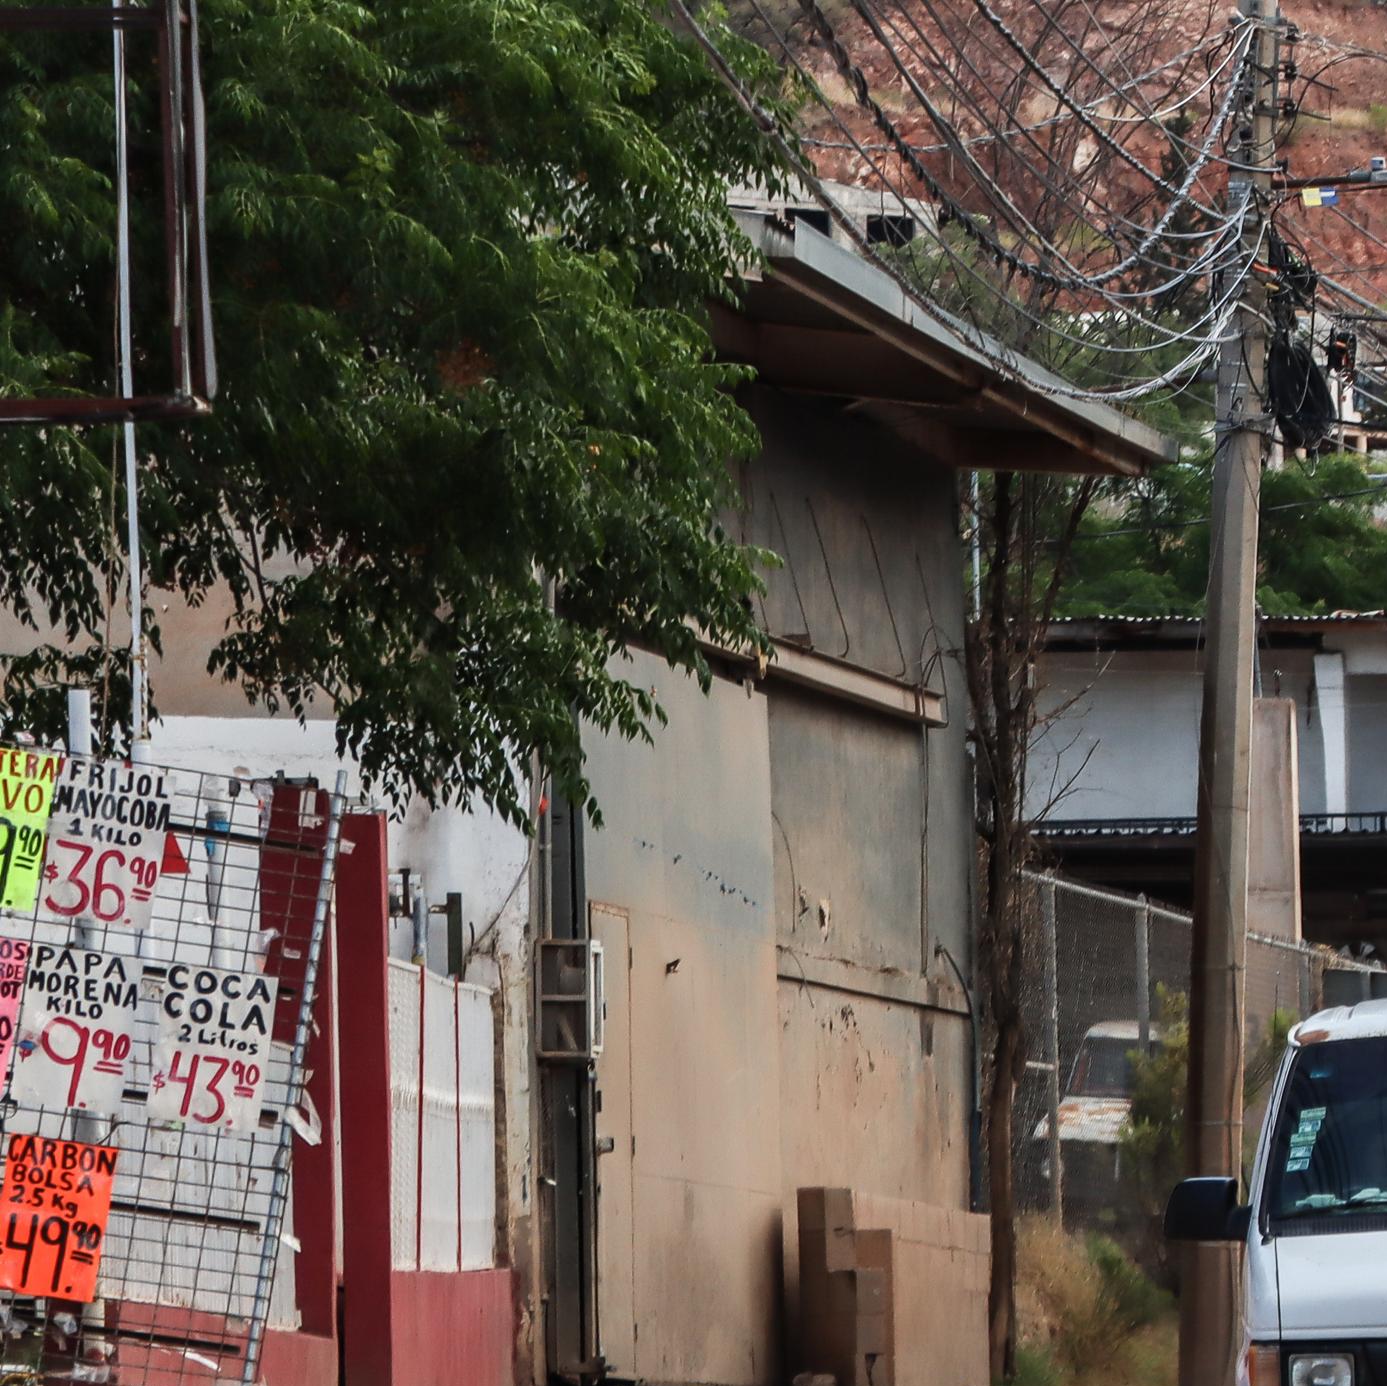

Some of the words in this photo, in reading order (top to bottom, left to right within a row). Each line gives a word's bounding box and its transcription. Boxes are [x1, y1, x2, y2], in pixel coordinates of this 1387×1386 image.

[70, 759, 168, 799] FRIJOL
[56, 785, 171, 832] MAYOCOBA
[66, 818, 83, 836] 1
[91, 824, 142, 846] KILO
[36, 946, 126, 982] PAPA
[29, 970, 138, 1011] MORENA
[168, 965, 270, 1003] COCA
[47, 995, 103, 1020] KILO
[164, 992, 267, 1035] COLA
[178, 1024, 192, 1043] 2
[9, 1134, 117, 1177] CARBON
[9, 1185, 45, 1207] 2.5
[12, 1163, 95, 1197] BOLSA
